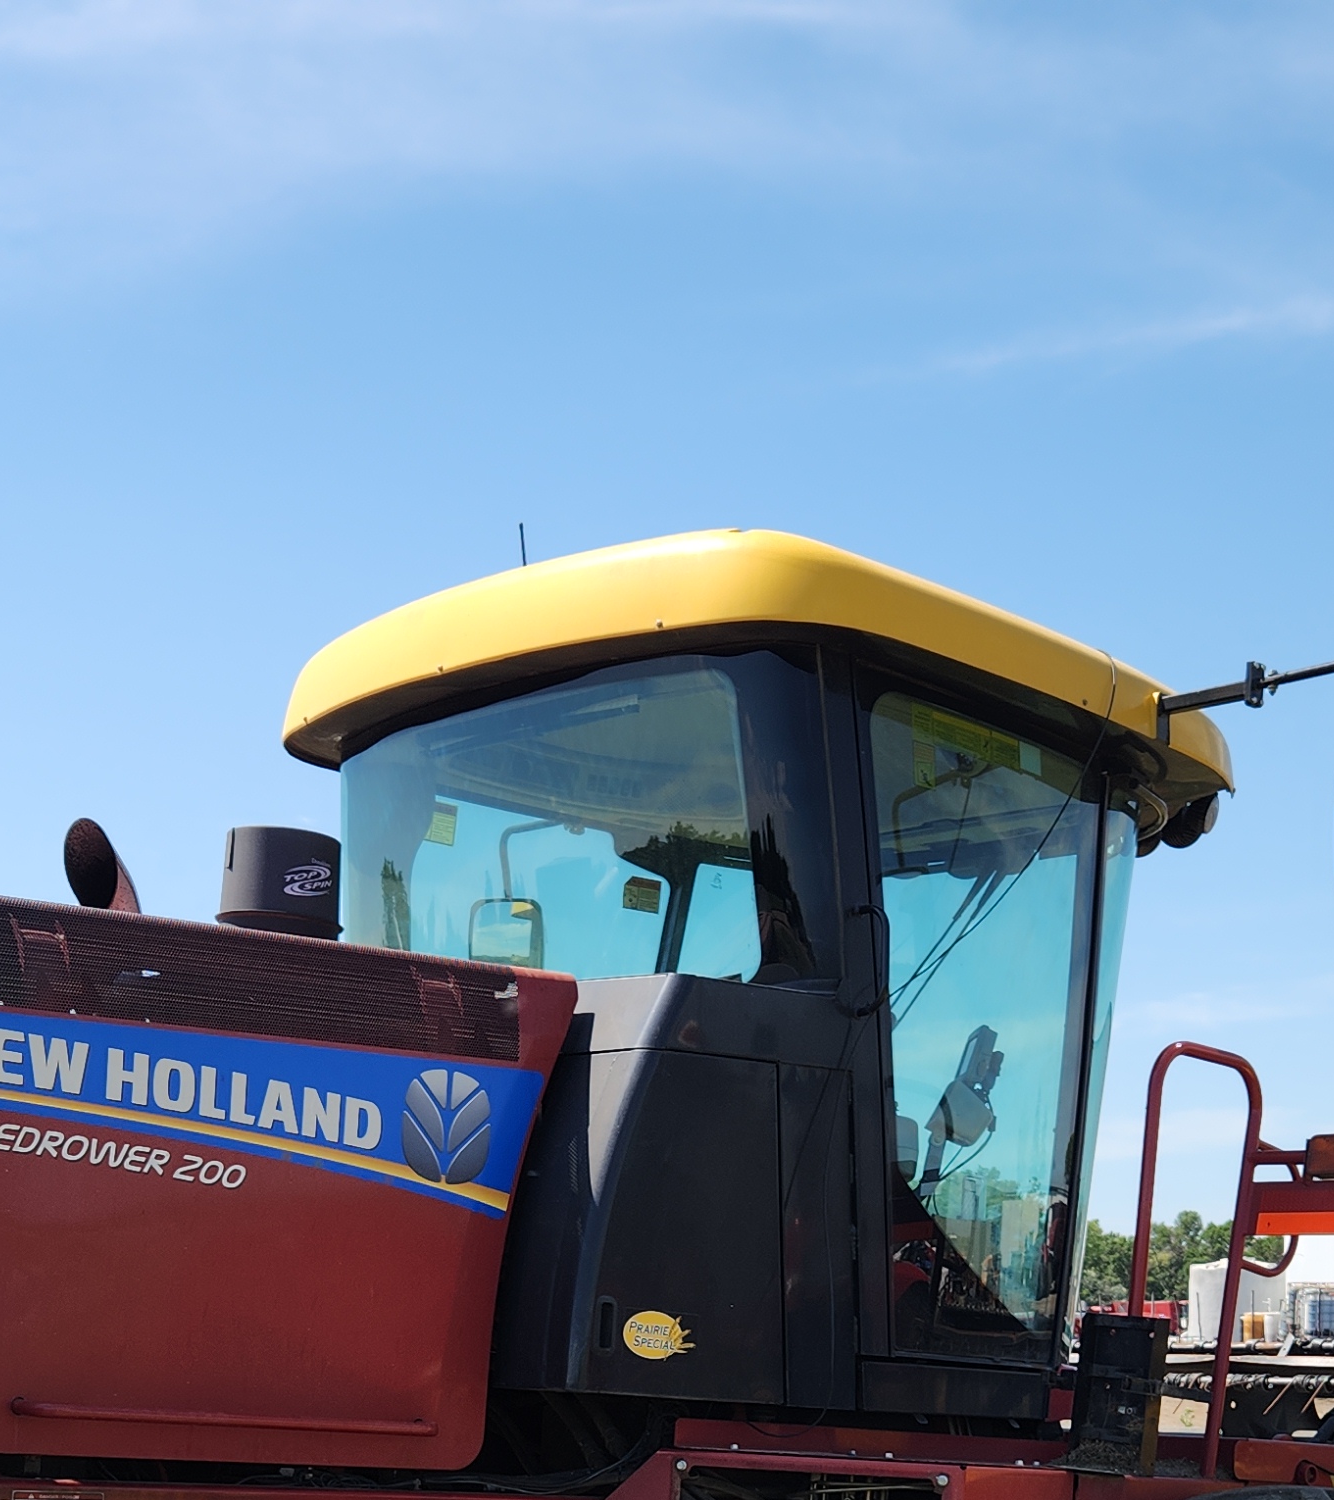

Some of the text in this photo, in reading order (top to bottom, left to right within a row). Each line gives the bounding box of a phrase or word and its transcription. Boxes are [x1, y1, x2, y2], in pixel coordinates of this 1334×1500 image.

[284, 871, 318, 882] TOP
[302, 880, 333, 891] SPIN
[105, 1047, 383, 1150] HOLLAND
[172, 1154, 247, 1189] 200
[629, 1321, 670, 1336] PRAIRIE
[633, 1335, 676, 1350] SPECIAL
